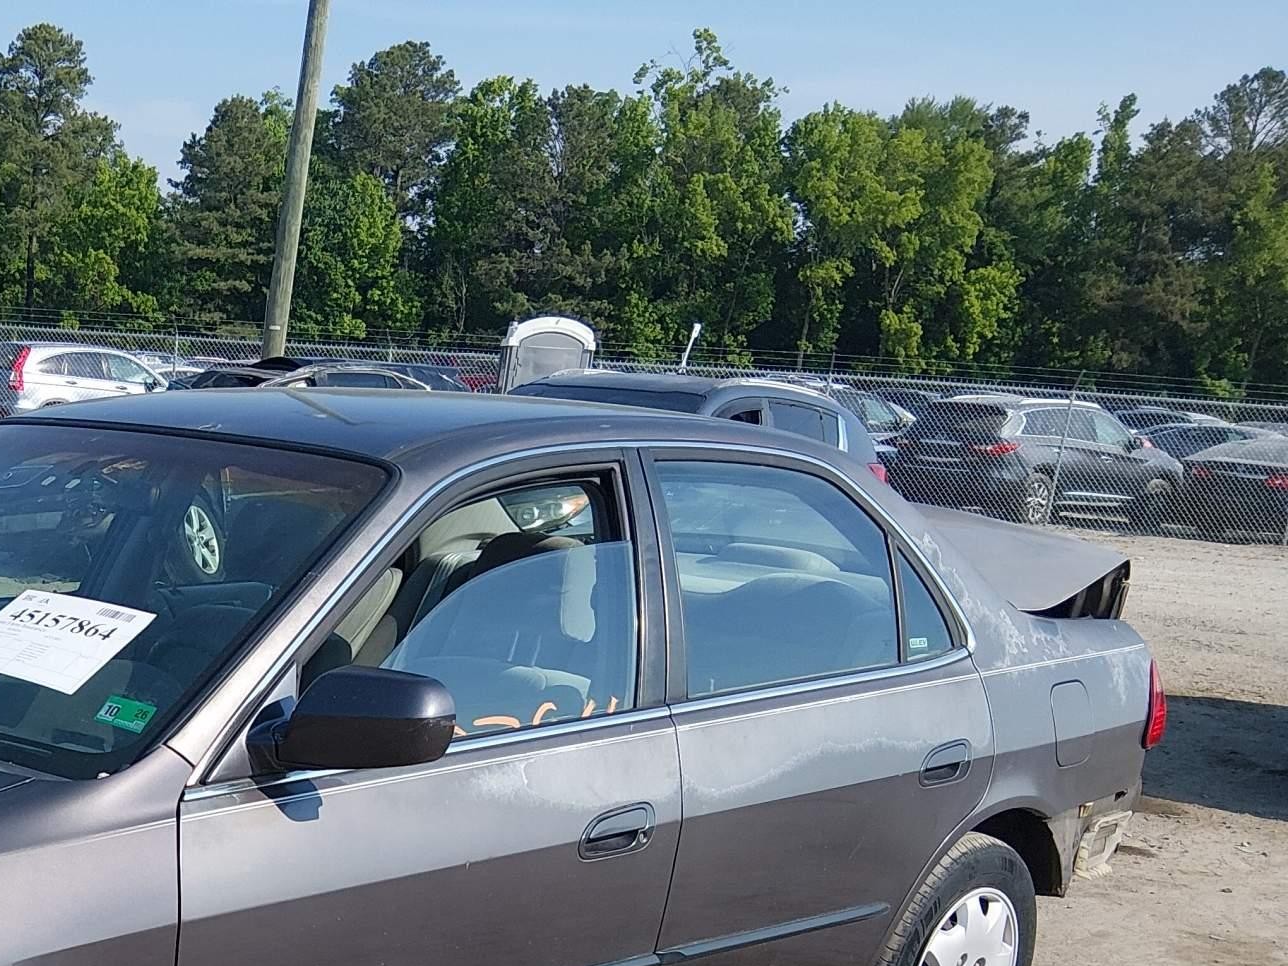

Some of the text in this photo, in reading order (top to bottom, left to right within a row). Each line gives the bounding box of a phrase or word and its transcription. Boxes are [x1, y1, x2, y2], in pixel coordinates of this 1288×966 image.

[9, 608, 118, 640] 45157864
[103, 704, 121, 717] 10
[134, 709, 150, 720] 26
